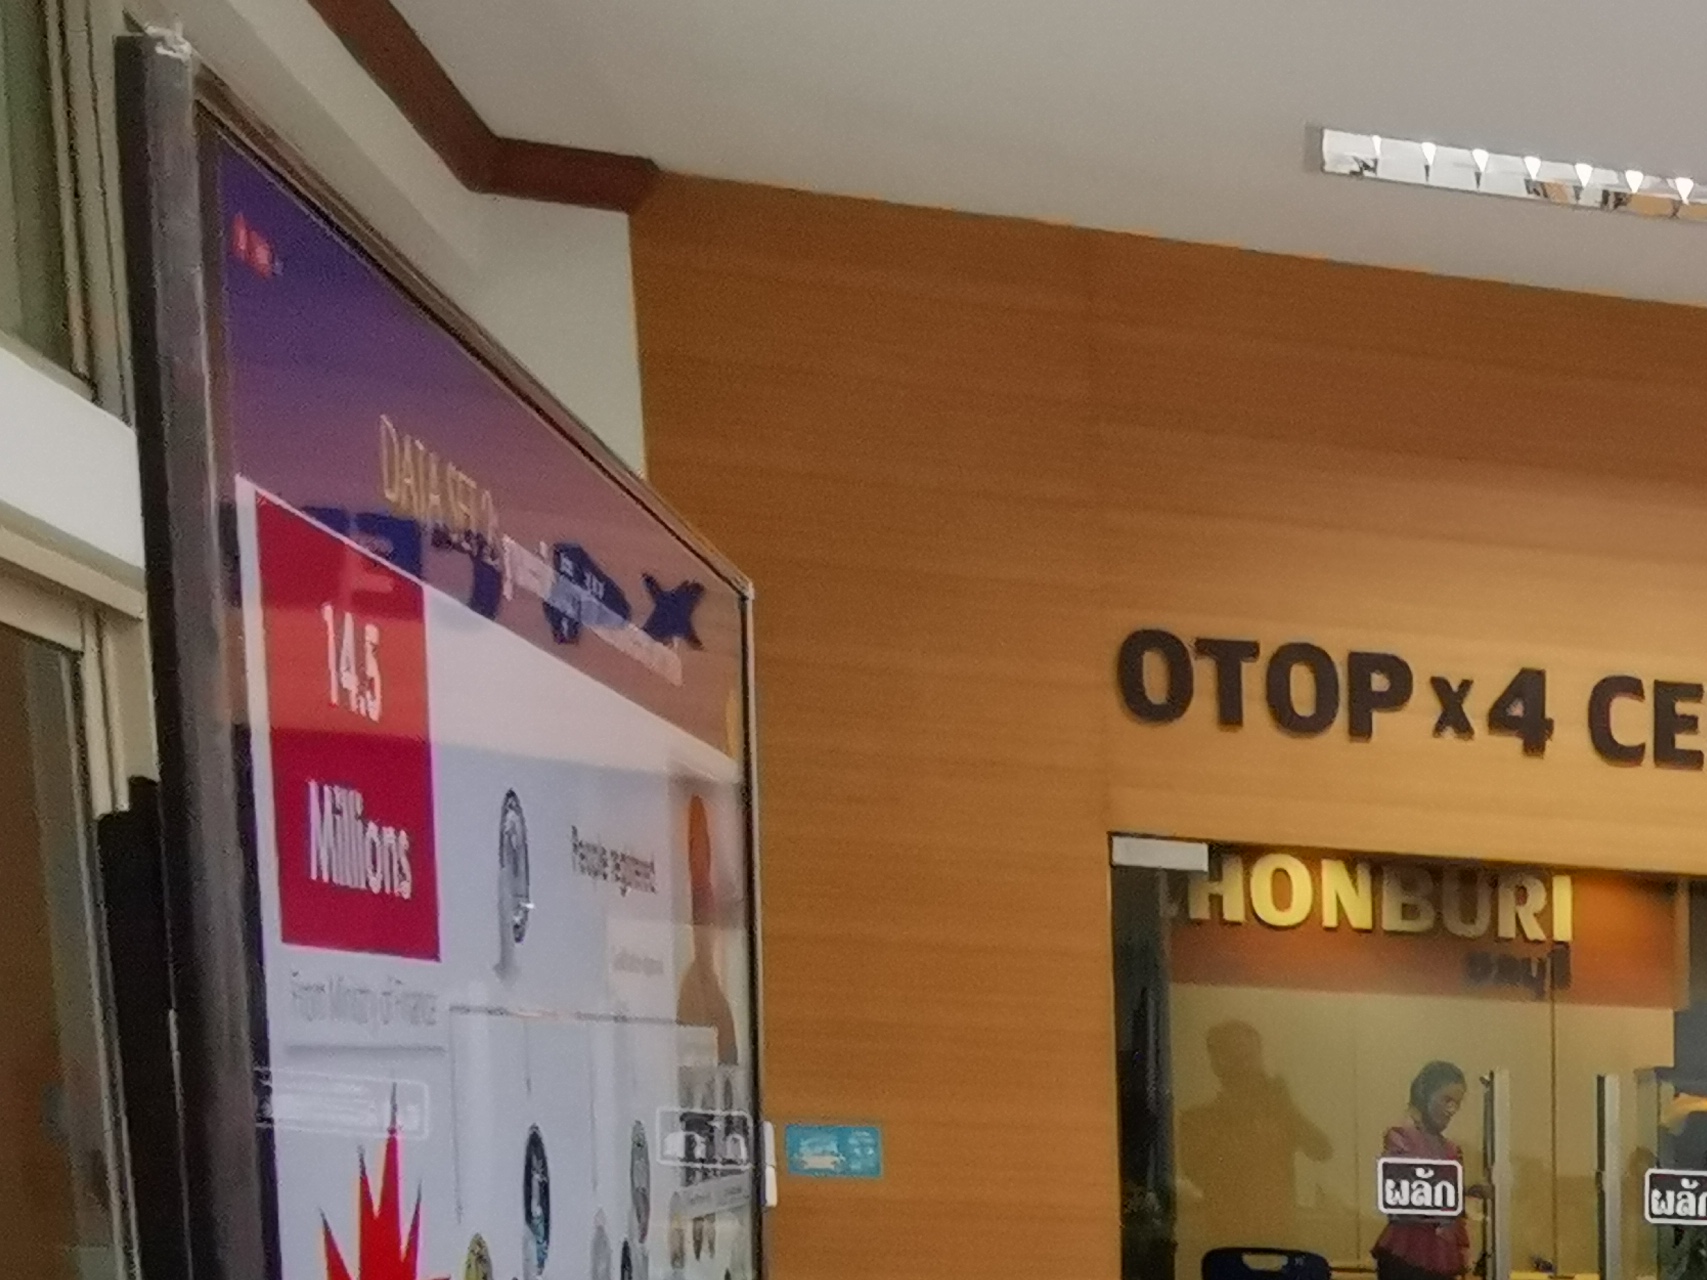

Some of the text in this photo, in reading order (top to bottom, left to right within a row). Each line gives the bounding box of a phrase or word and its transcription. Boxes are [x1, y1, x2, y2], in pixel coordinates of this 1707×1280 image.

[308, 778, 412, 899] Millions
[1164, 853, 1574, 943] HONBURI
[1384, 1166, 1457, 1208] ผลัก
